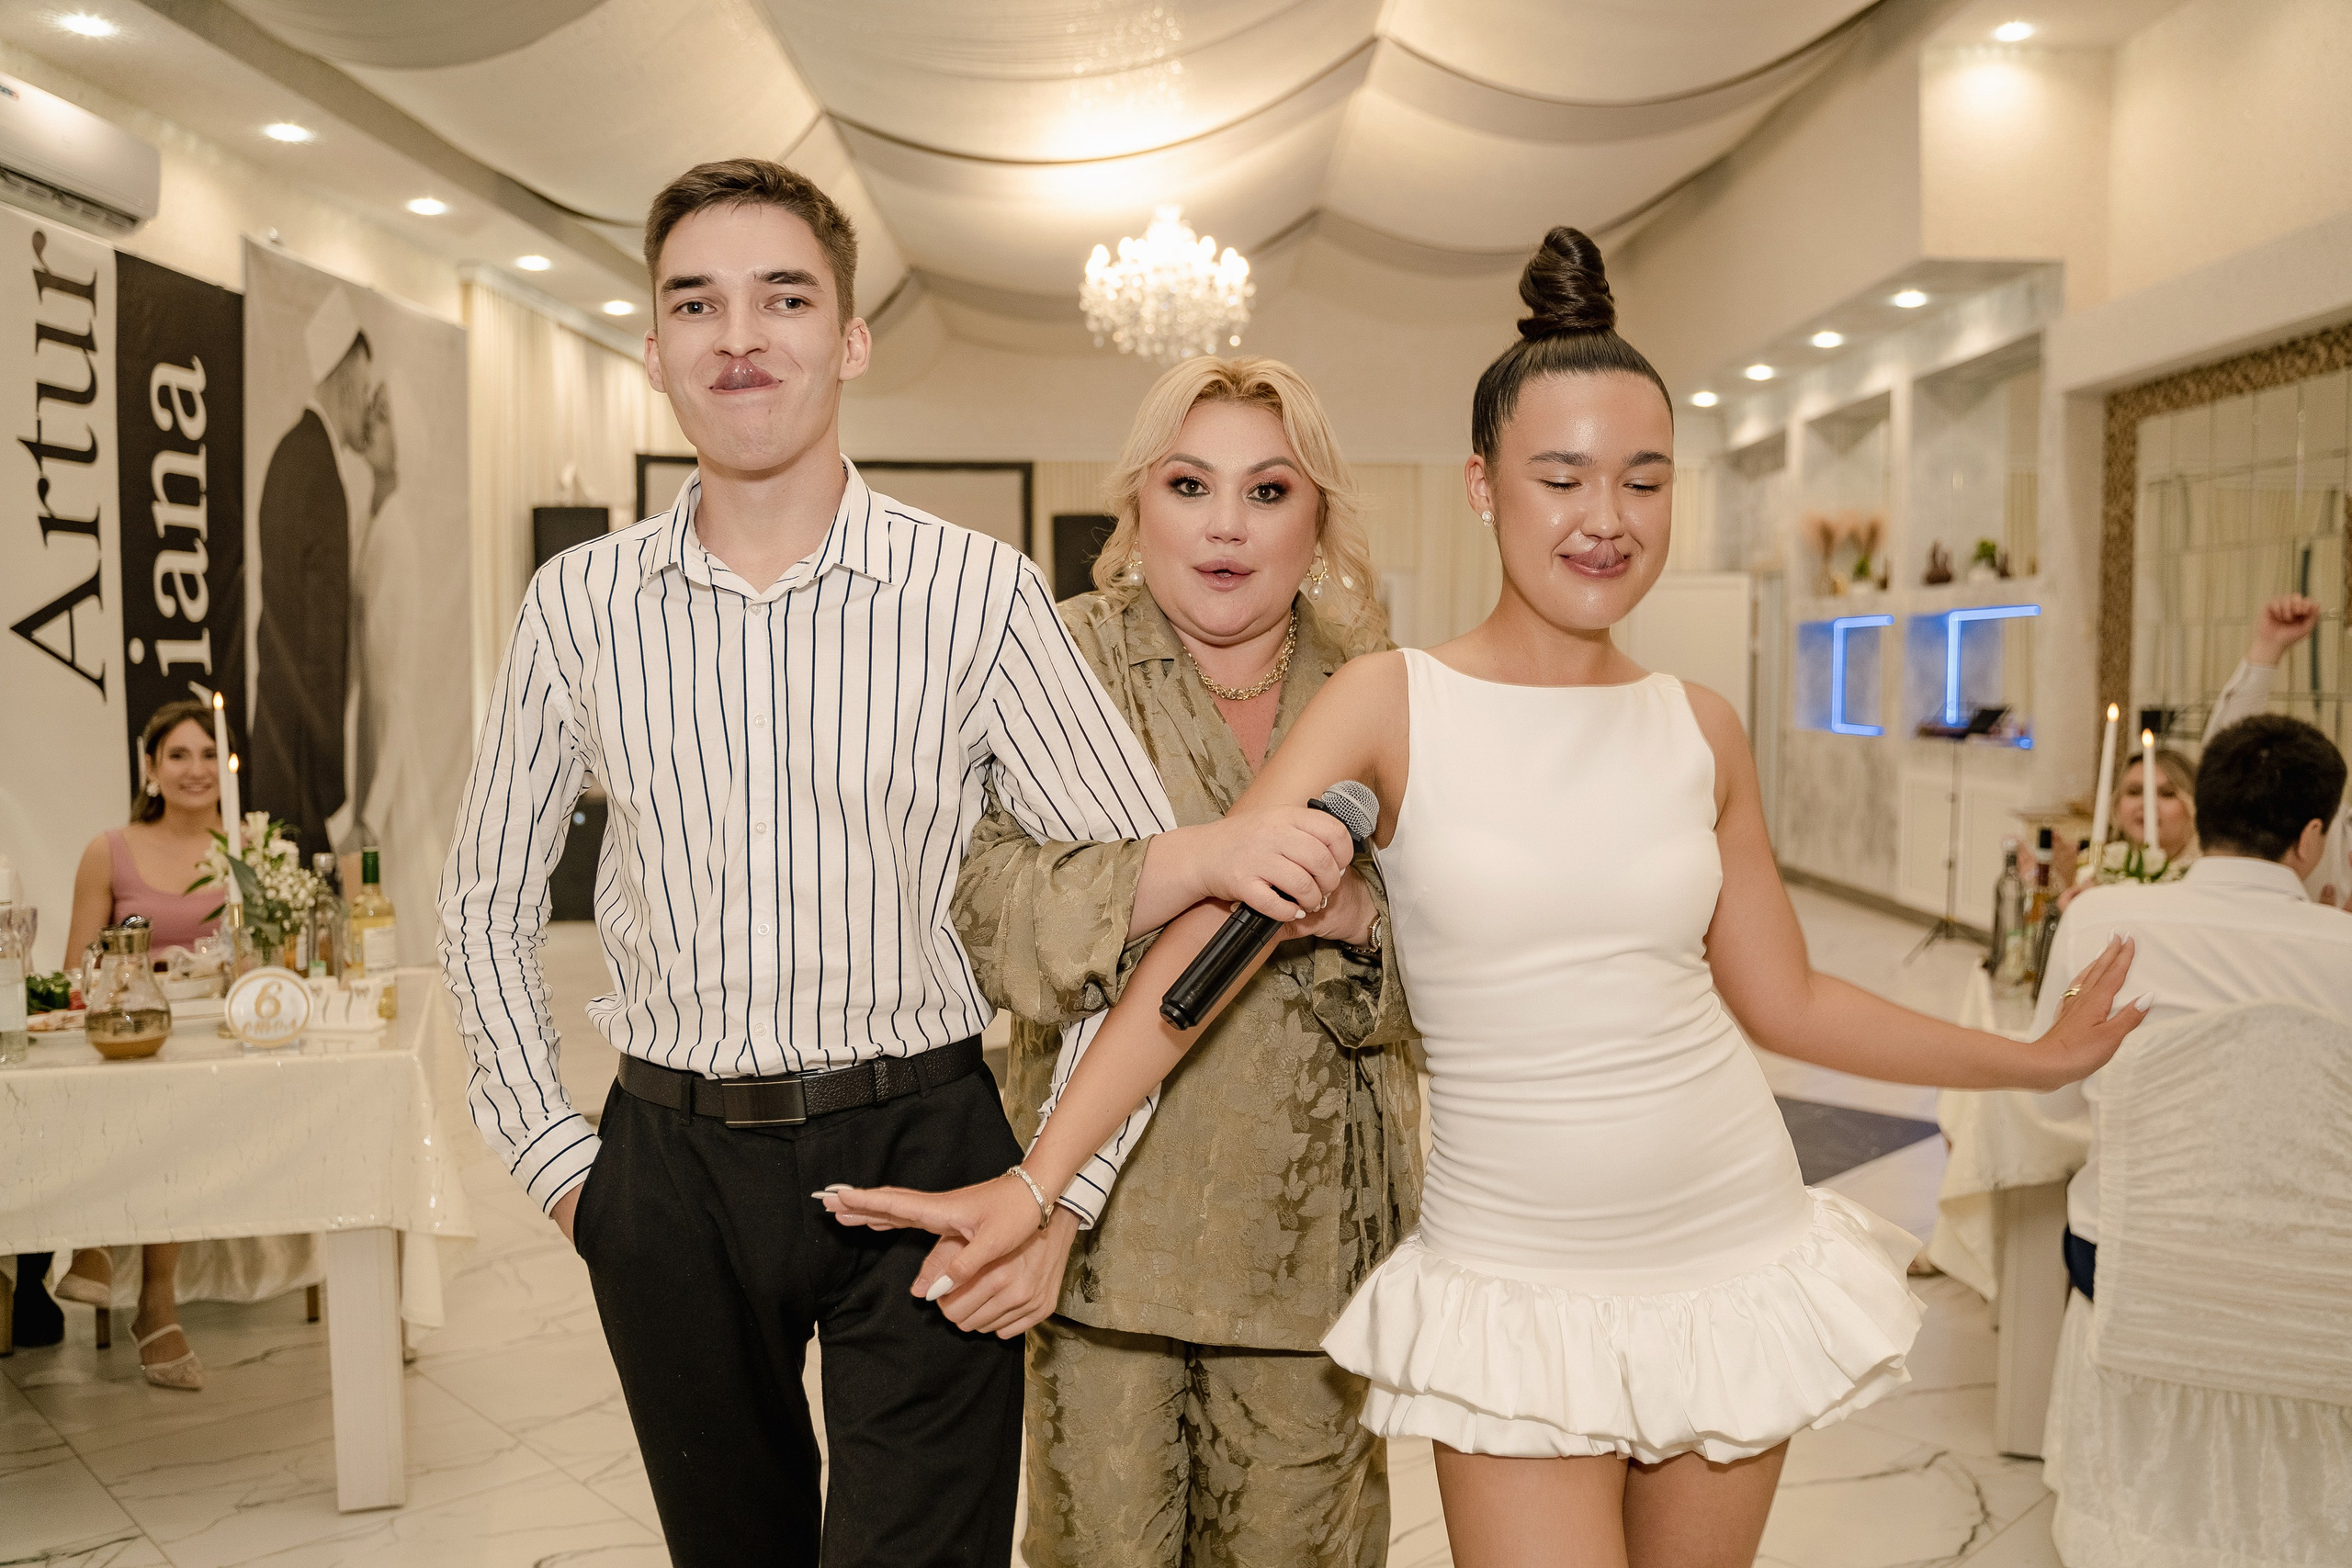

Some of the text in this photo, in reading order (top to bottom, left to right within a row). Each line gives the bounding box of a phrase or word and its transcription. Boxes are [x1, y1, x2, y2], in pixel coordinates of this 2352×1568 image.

[9, 229, 107, 705] Artur
[128, 355, 214, 791] iana
[254, 980, 283, 1020] 6
